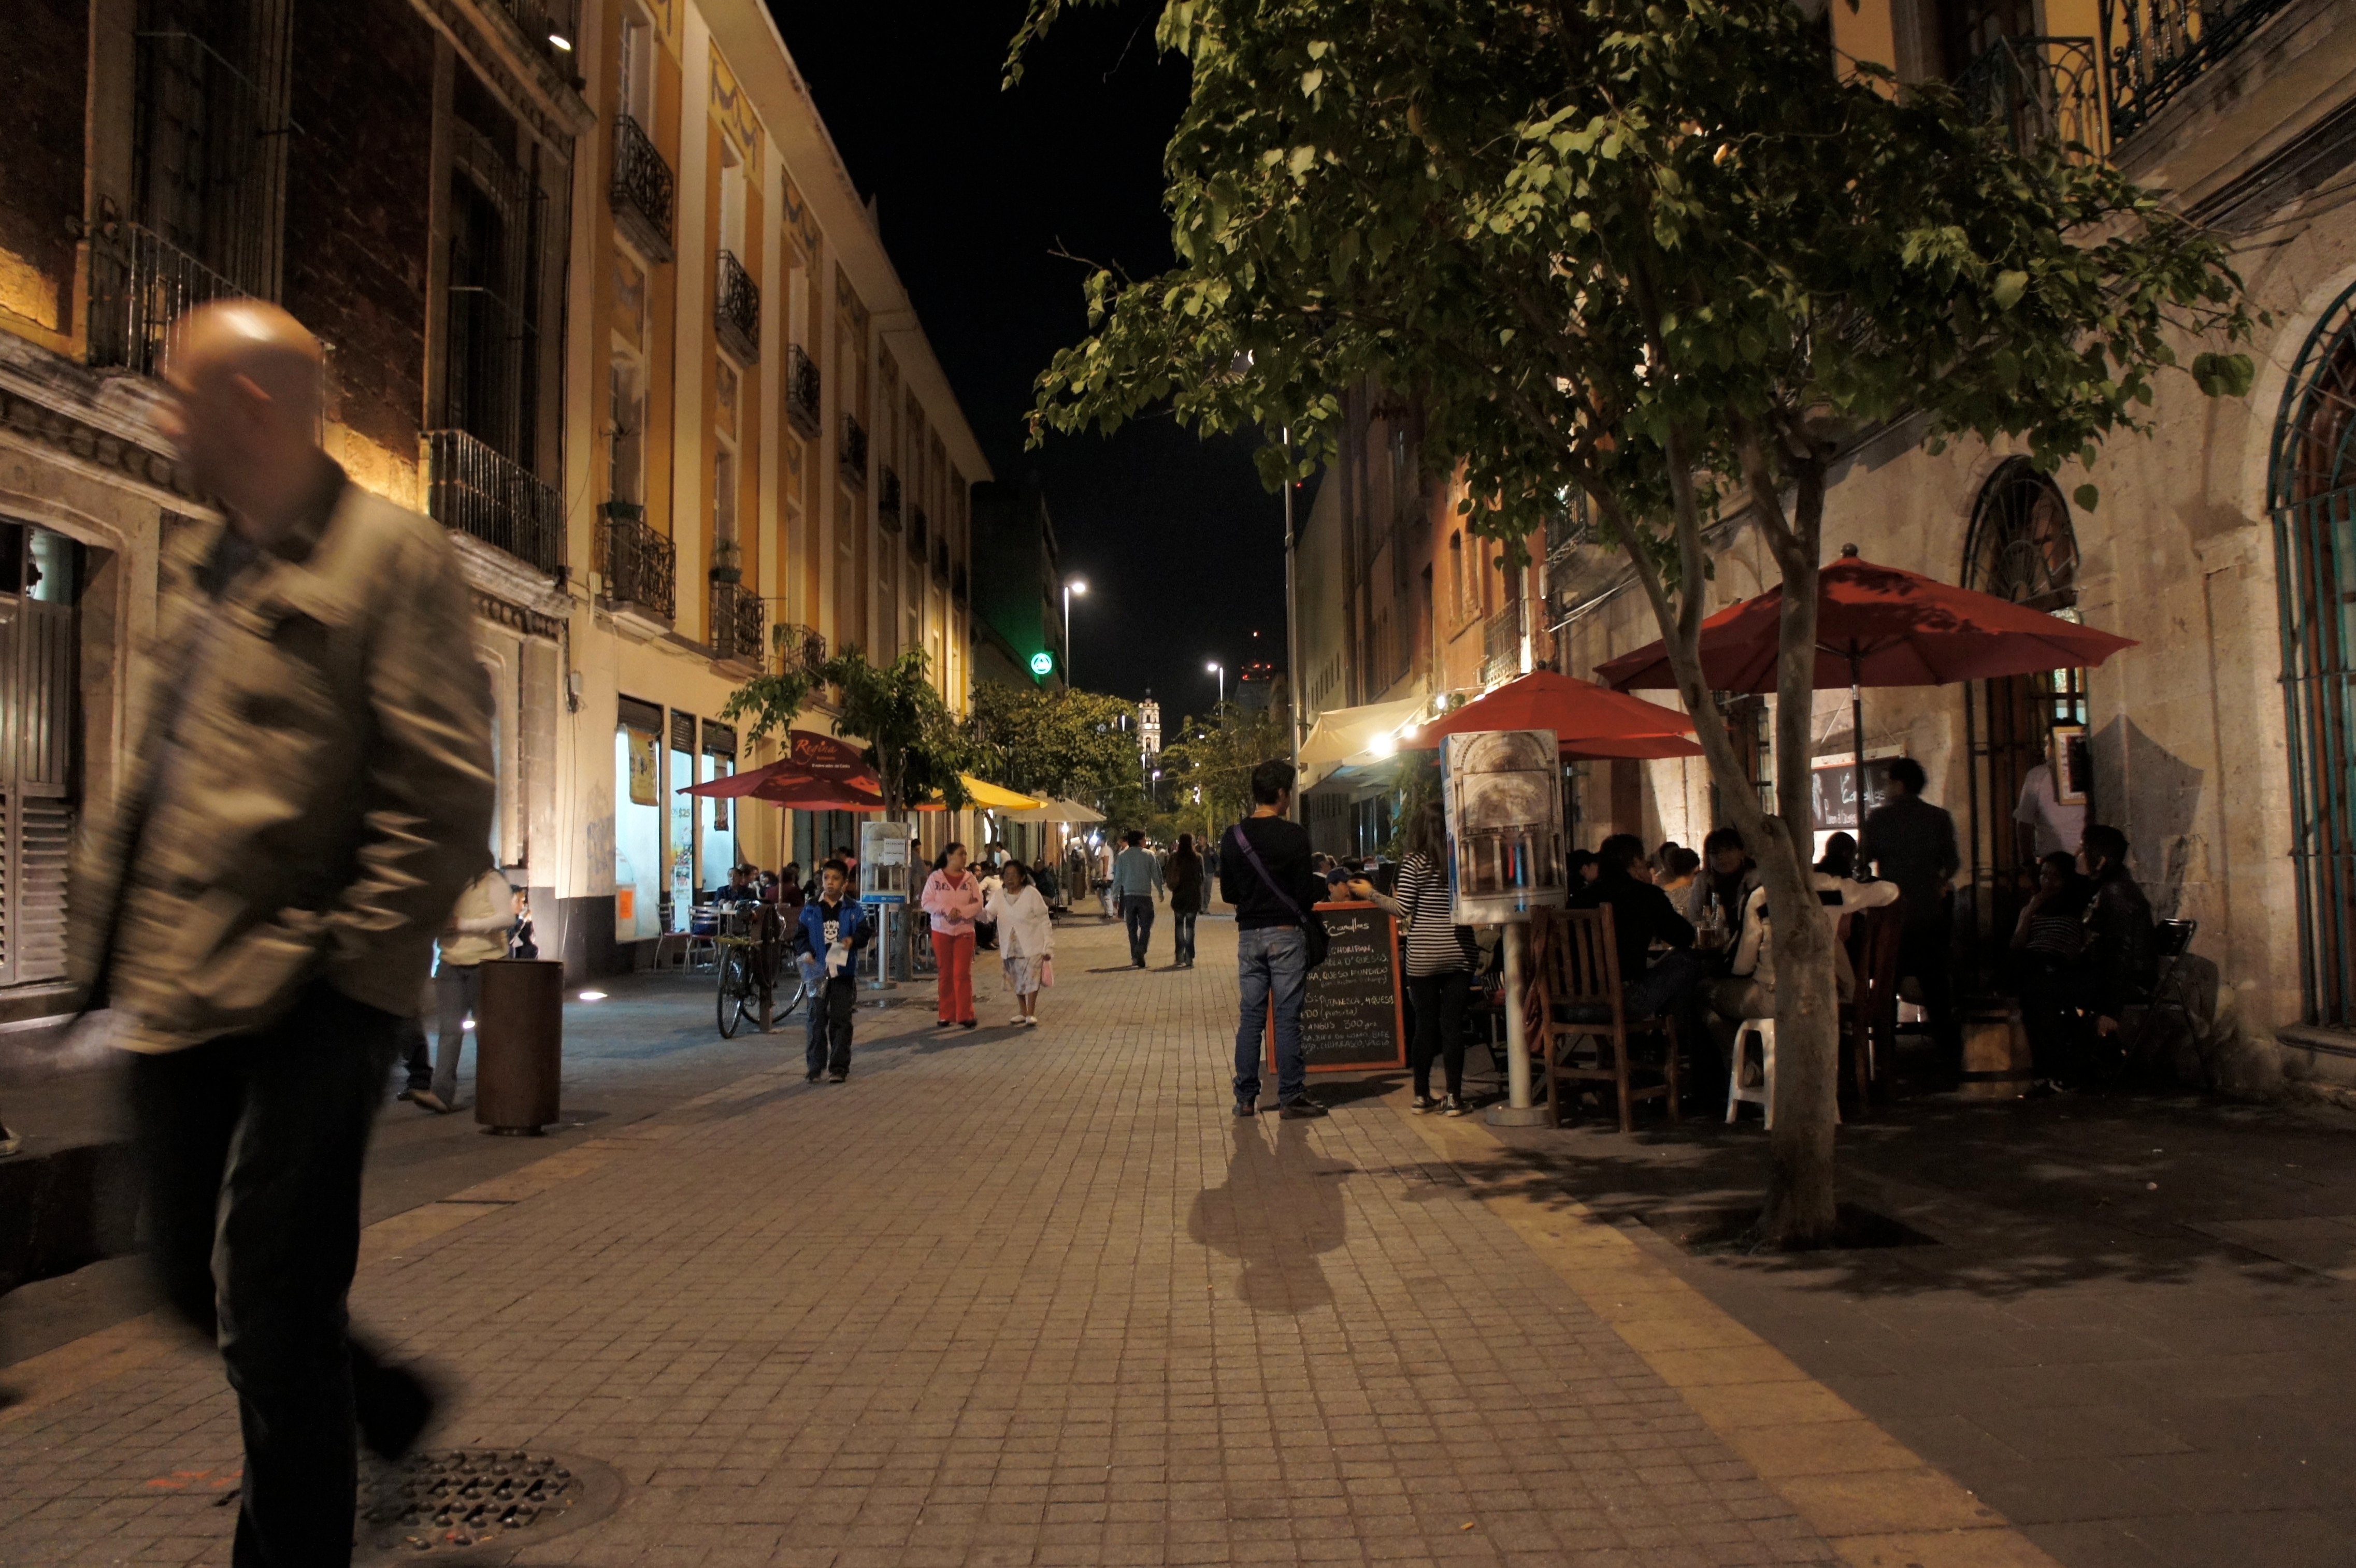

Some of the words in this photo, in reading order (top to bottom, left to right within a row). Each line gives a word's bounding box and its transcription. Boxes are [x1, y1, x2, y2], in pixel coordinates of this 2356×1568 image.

[795, 739, 838, 765] Regina
[679, 807, 691, 818] $25
[1323, 970, 1348, 980] QUESO
[1351, 967, 1388, 976] FUNDIDO
[1343, 1019, 1363, 1030] 300
